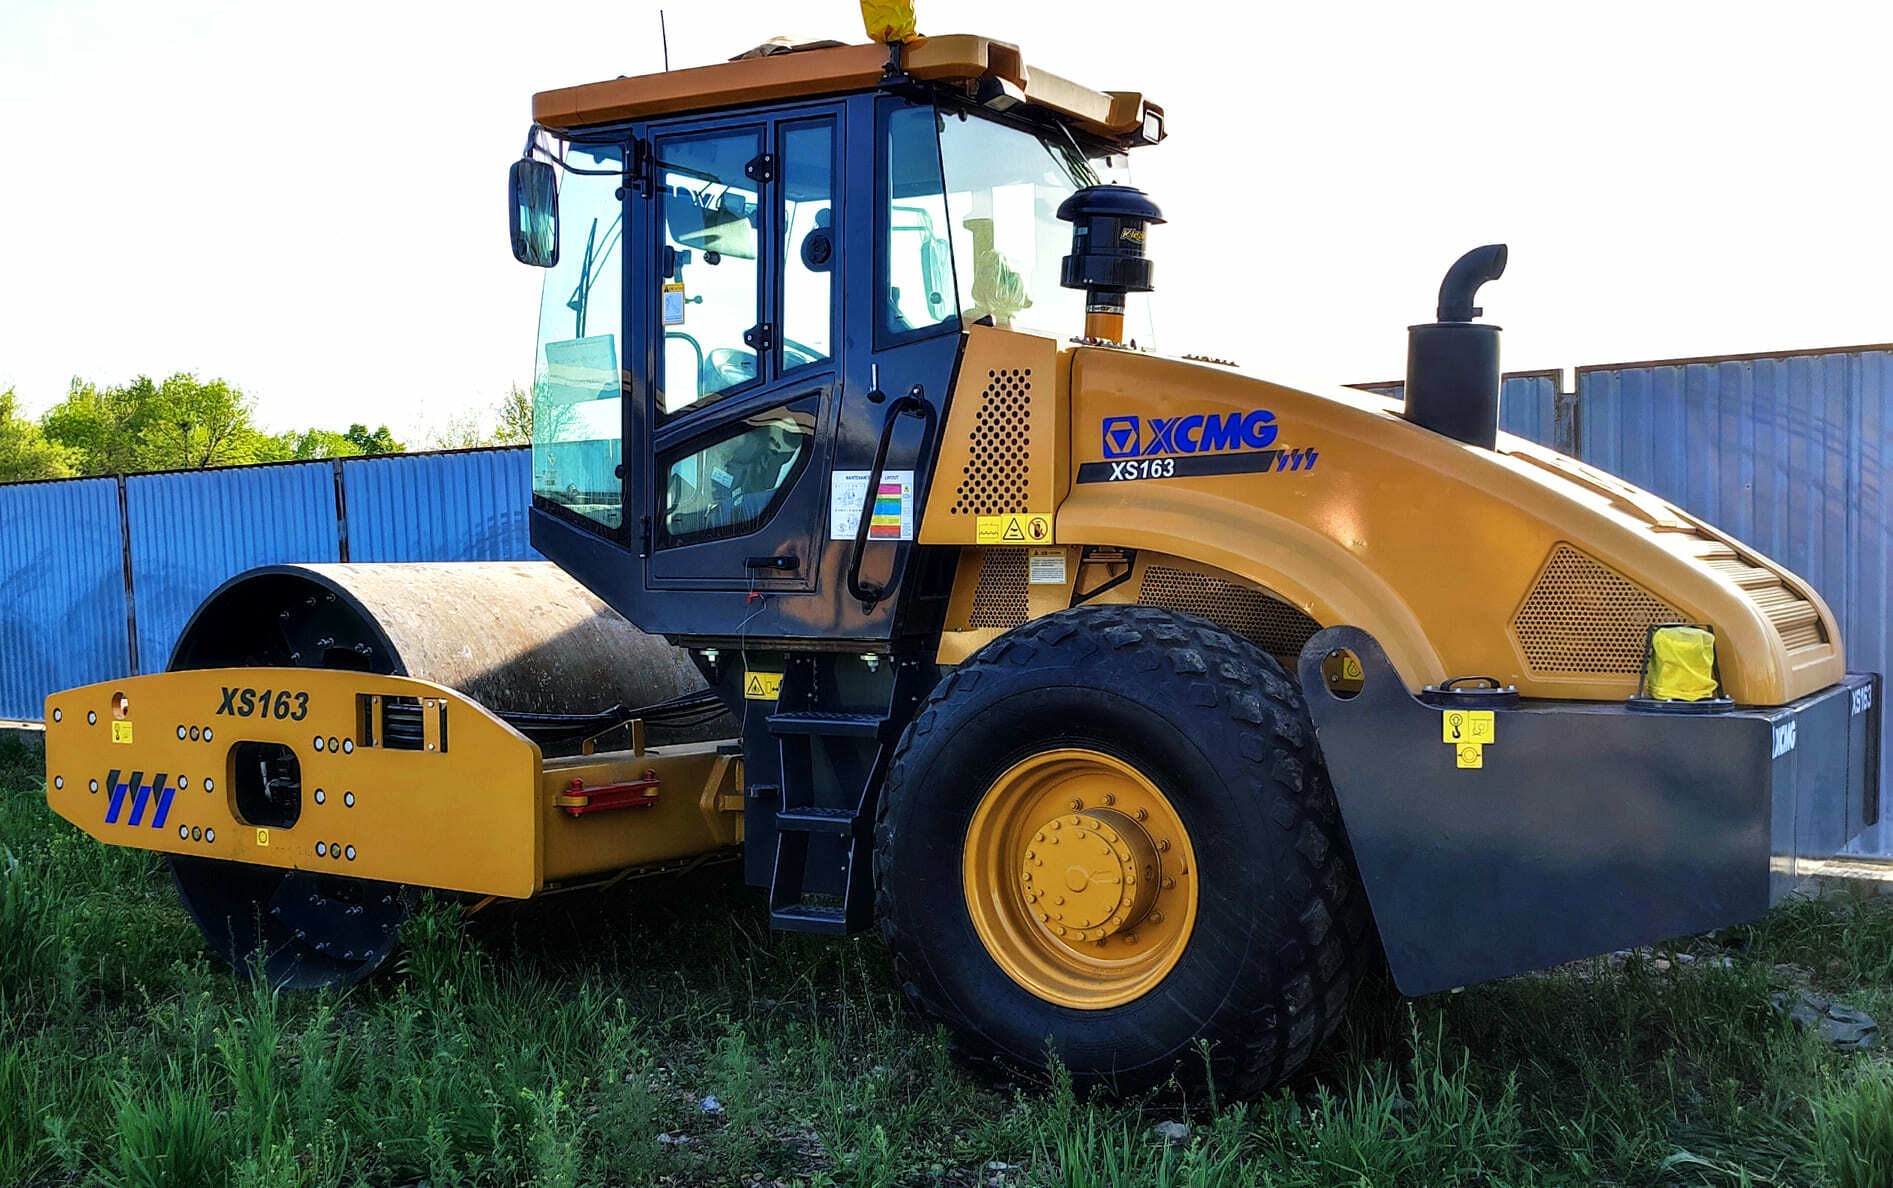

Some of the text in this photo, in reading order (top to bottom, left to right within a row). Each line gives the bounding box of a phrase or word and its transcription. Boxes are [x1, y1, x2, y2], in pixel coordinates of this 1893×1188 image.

[1142, 410, 1278, 455] XCMG
[1109, 458, 1175, 481] XS163
[215, 687, 309, 721] XS163
[1851, 683, 1872, 717] XS163
